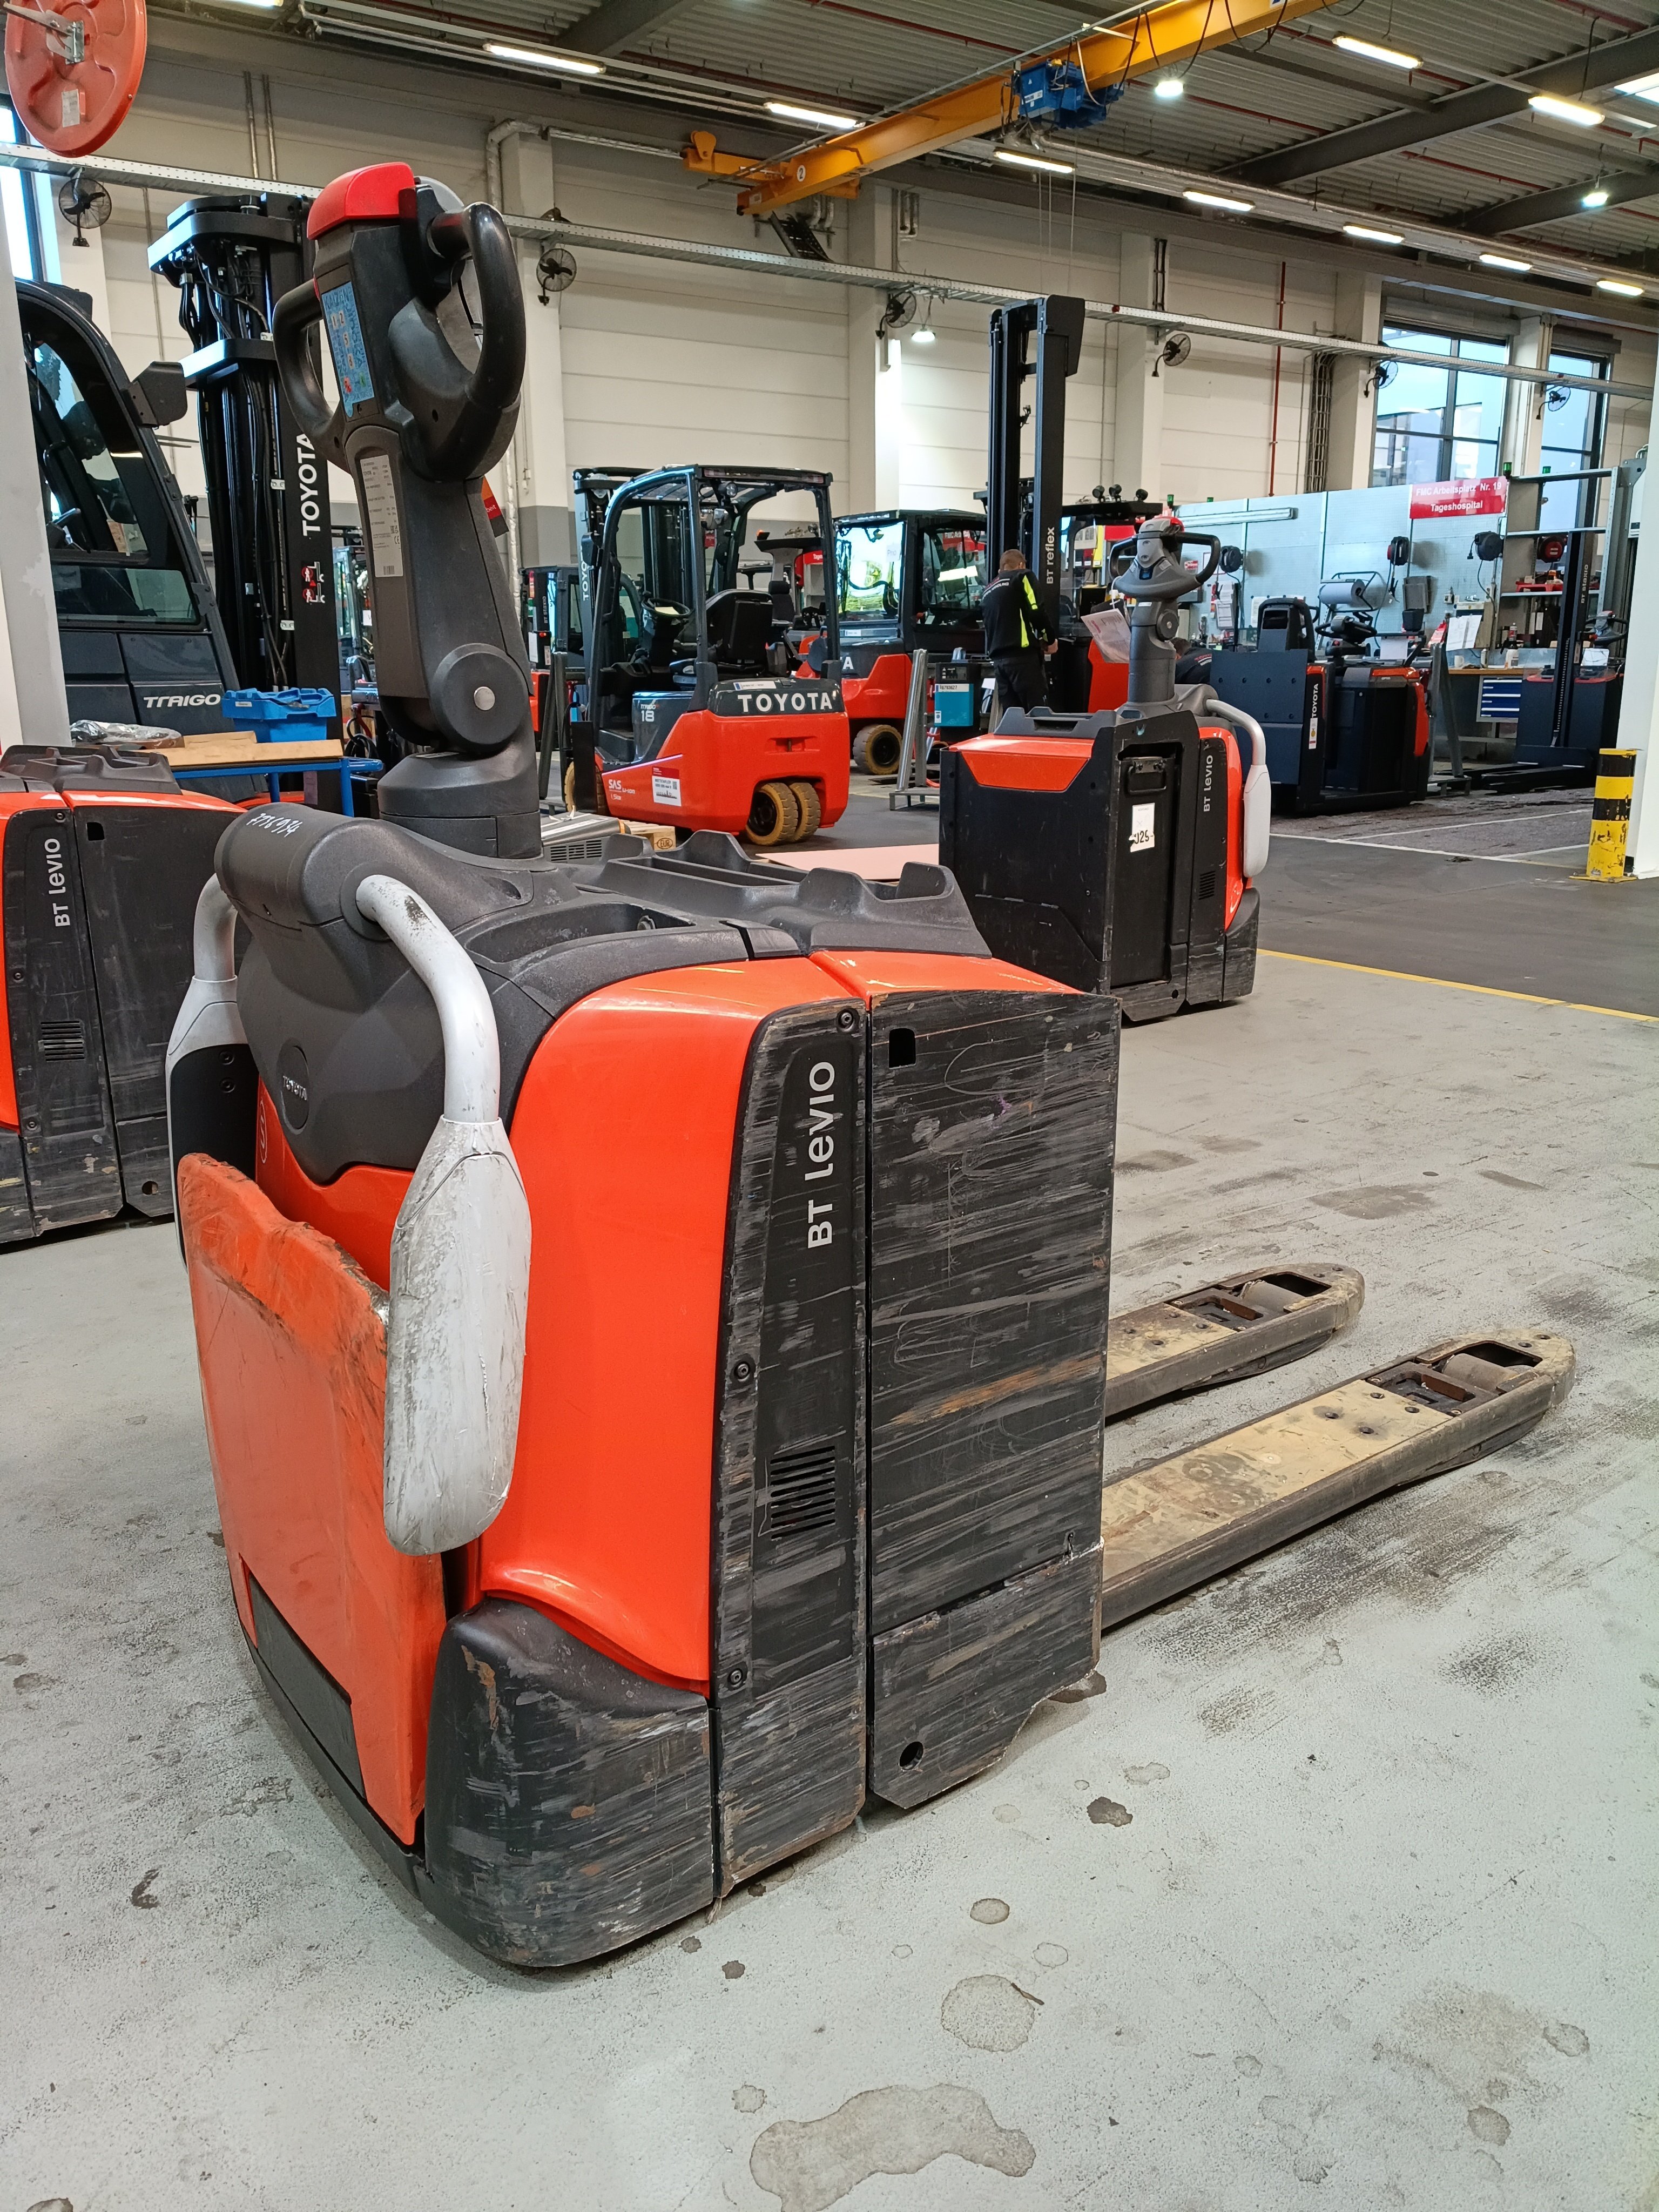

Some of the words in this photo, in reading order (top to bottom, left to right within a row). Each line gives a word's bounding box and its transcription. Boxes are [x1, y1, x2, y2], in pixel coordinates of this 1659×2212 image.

[799, 167, 804, 179] 2
[296, 434, 321, 536] TOYOTA
[1416, 488, 1432, 496] FMC
[1433, 484, 1476, 495] Arbeitsplatz
[1480, 483, 1491, 491] Nr.
[1493, 482, 1502, 490] 19
[1431, 501, 1483, 513] Tageshospital
[1046, 527, 1055, 565] reflex
[1047, 569, 1054, 584] BT
[143, 694, 221, 709] TRAIGO
[737, 692, 832, 712] TOYOTA
[641, 710, 655, 722] 18
[608, 779, 622, 790] SAS
[1203, 796, 1211, 812] BT
[660, 839, 670, 848] EUR
[52, 902, 71, 927] BT
[282, 1075, 308, 1101] TOYOTA
[807, 1199, 833, 1250] BT
